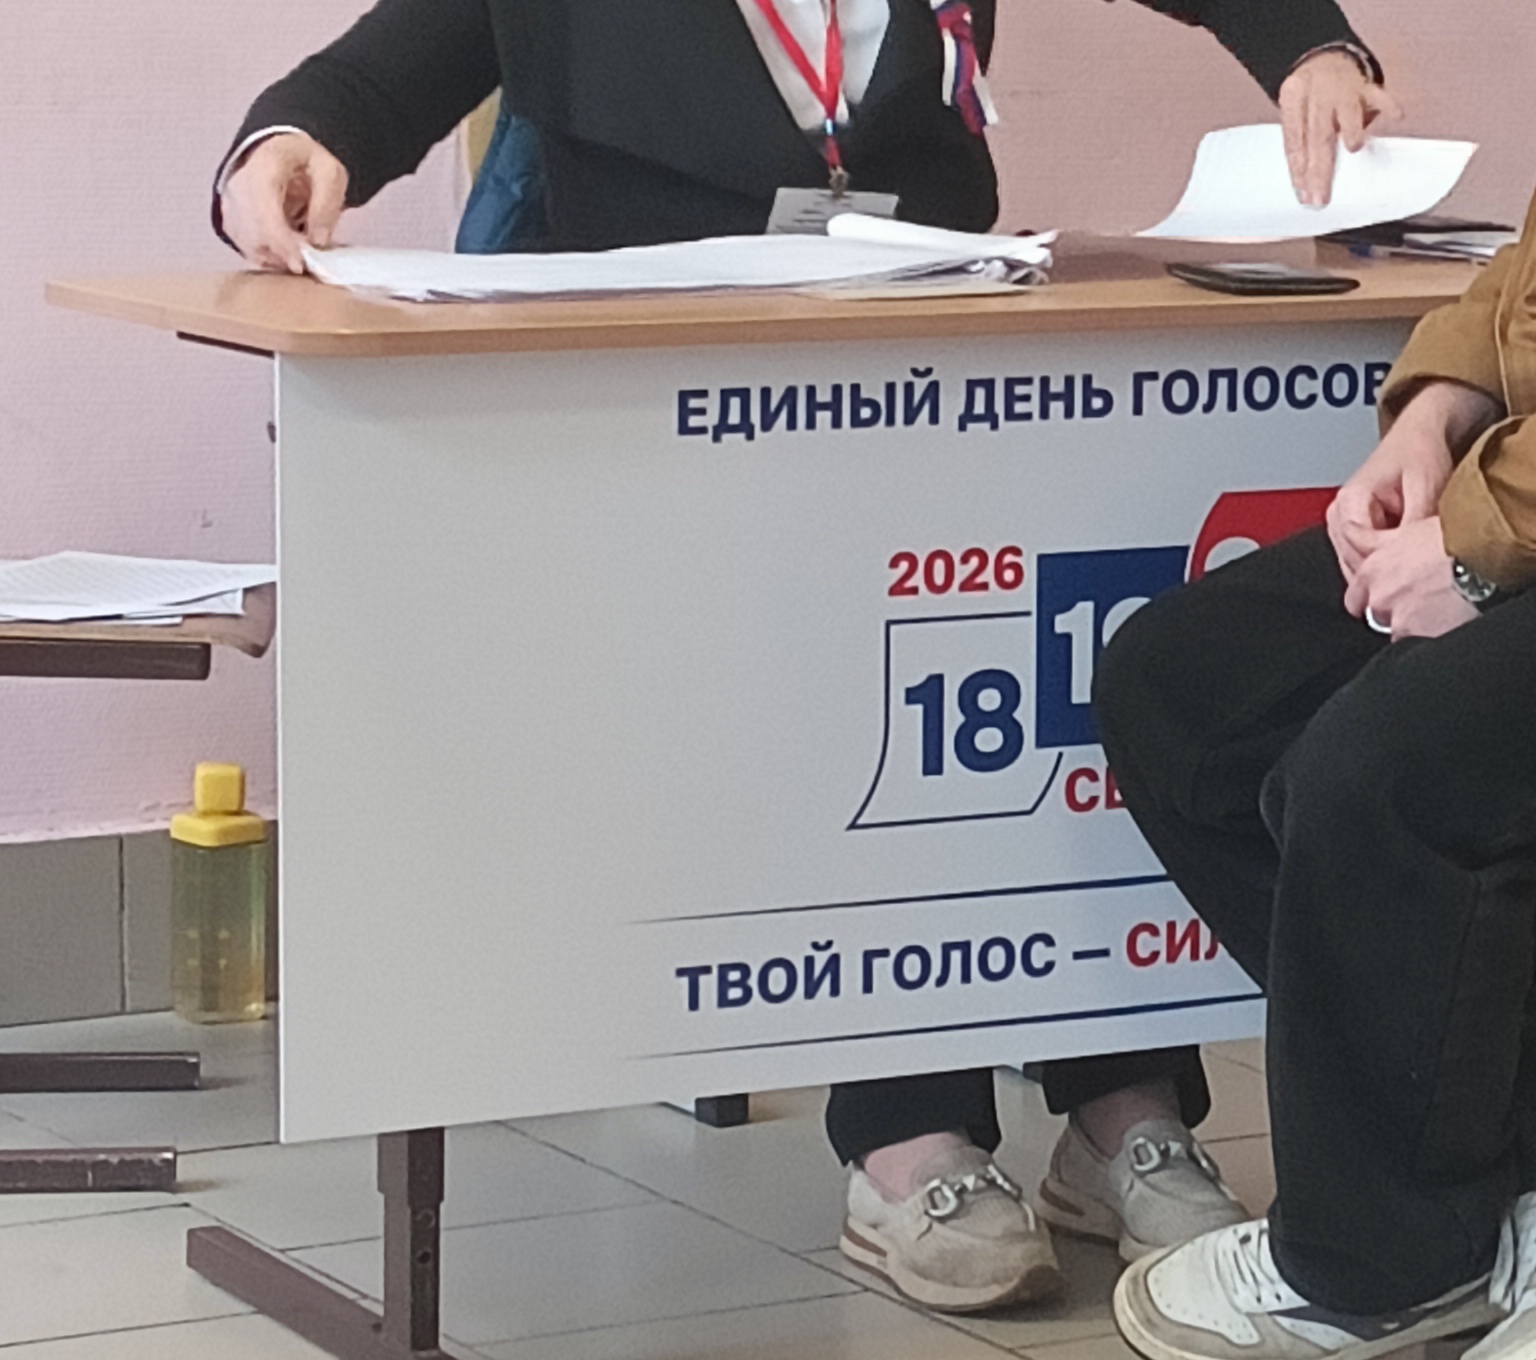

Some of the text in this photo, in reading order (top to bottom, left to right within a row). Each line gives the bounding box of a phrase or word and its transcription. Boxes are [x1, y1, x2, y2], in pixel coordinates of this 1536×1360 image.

[677, 368, 942, 442] ЕДИНЫЙ
[957, 375, 1115, 432] ДЕНЬ
[887, 546, 1025, 596] 2026
[1054, 597, 1152, 704] 1
[904, 669, 1024, 777] 18
[675, 941, 843, 1012] ТВОЙ
[862, 933, 1056, 994] ГОЛОС
